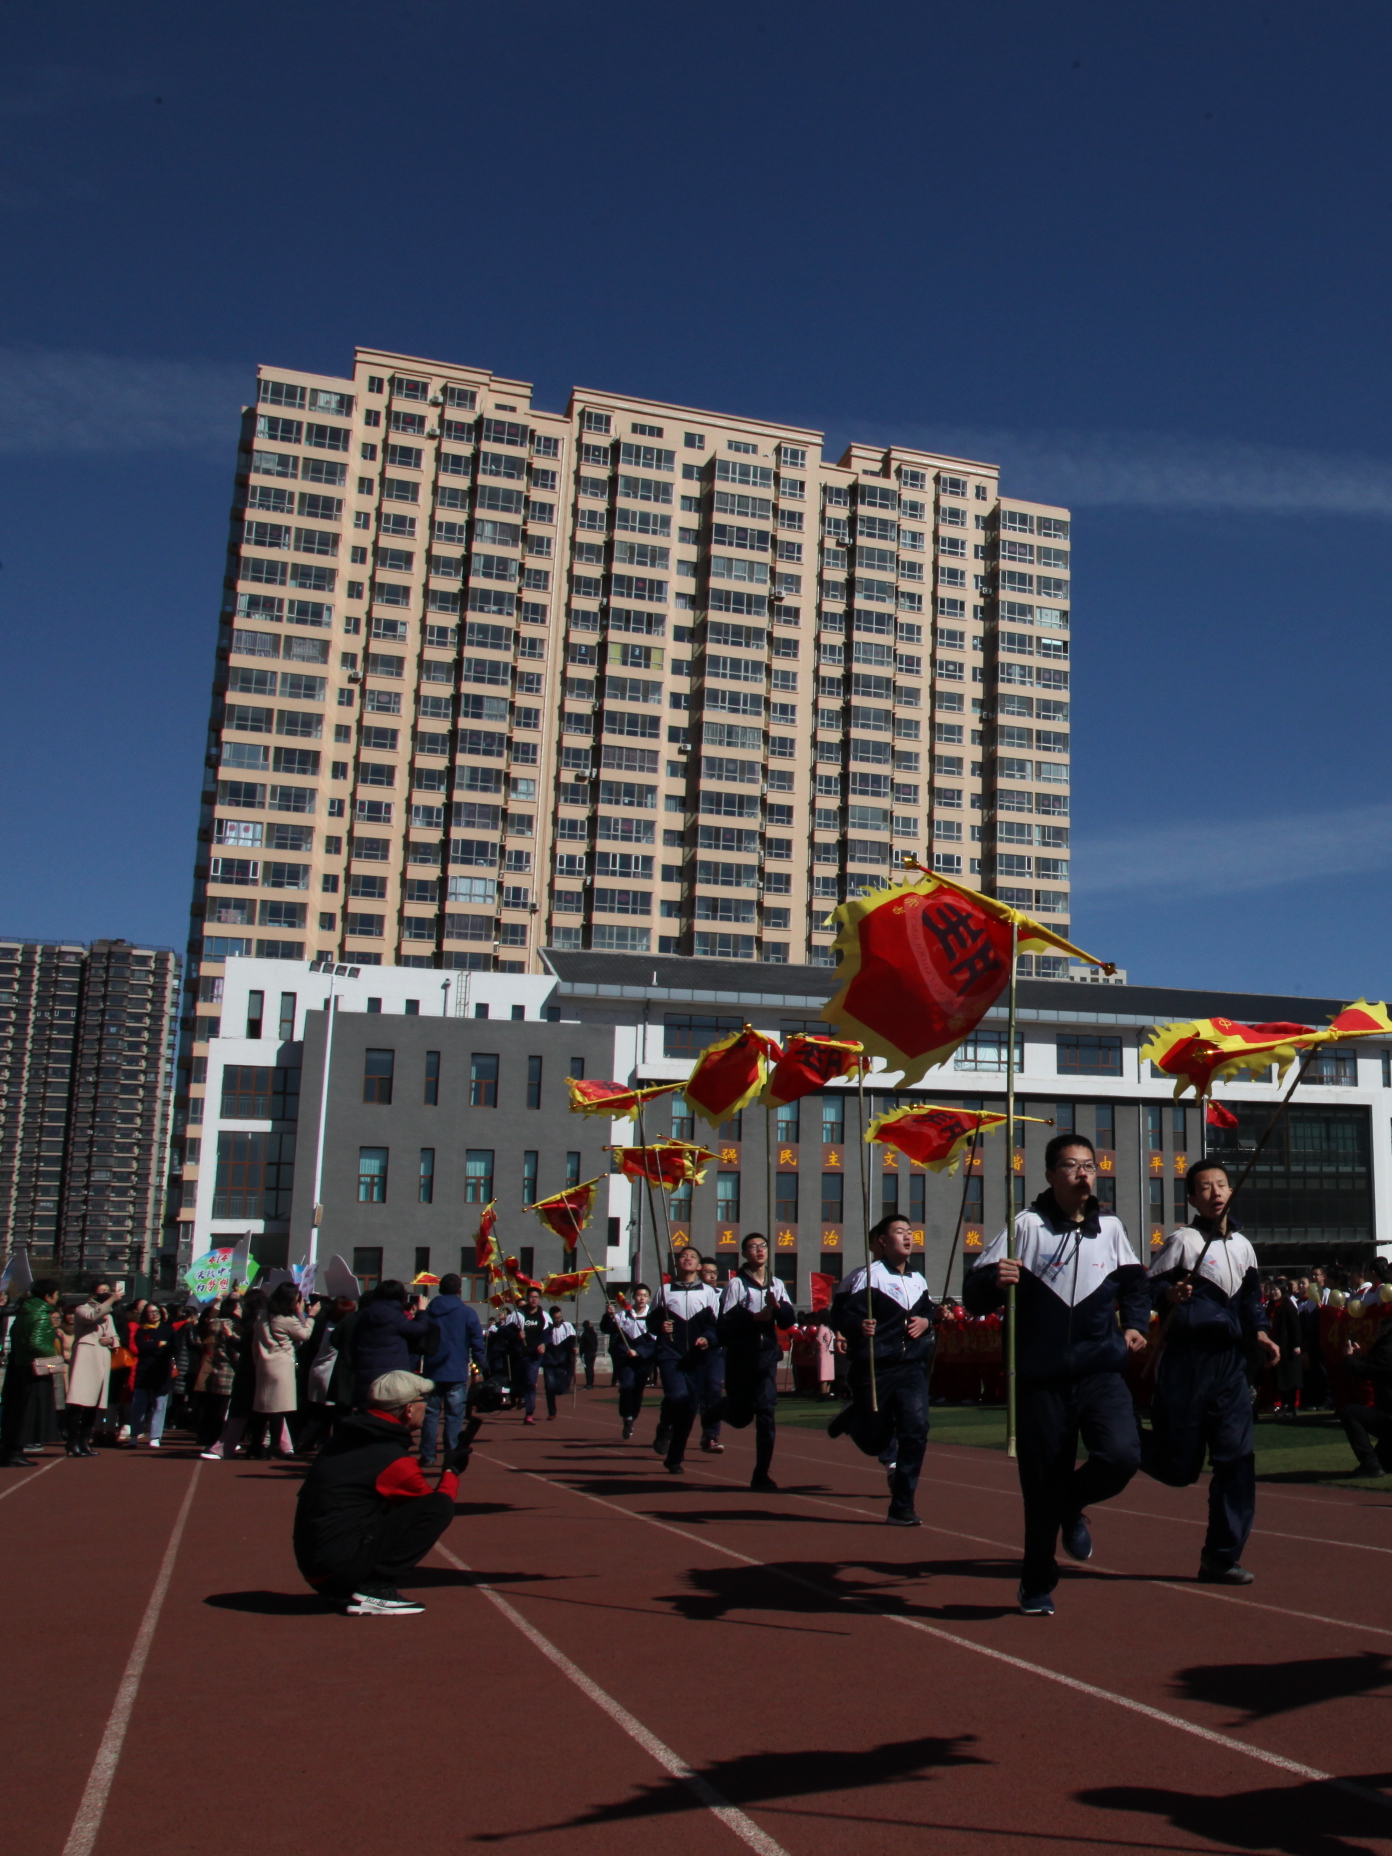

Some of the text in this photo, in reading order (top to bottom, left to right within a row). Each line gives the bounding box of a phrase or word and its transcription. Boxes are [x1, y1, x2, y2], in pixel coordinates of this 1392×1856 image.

[779, 1149, 797, 1166] 民
[825, 1151, 841, 1167] 主
[883, 1151, 898, 1167] 文
[1100, 1156, 1113, 1171] 由
[1149, 1156, 1164, 1173] 平
[1173, 1156, 1188, 1173] 等
[671, 1229, 691, 1247] 公
[719, 1230, 736, 1245] 正
[778, 1229, 795, 1247] 法
[823, 1229, 840, 1246] 治
[966, 1229, 983, 1246] 敬
[1150, 1229, 1164, 1245] 友
